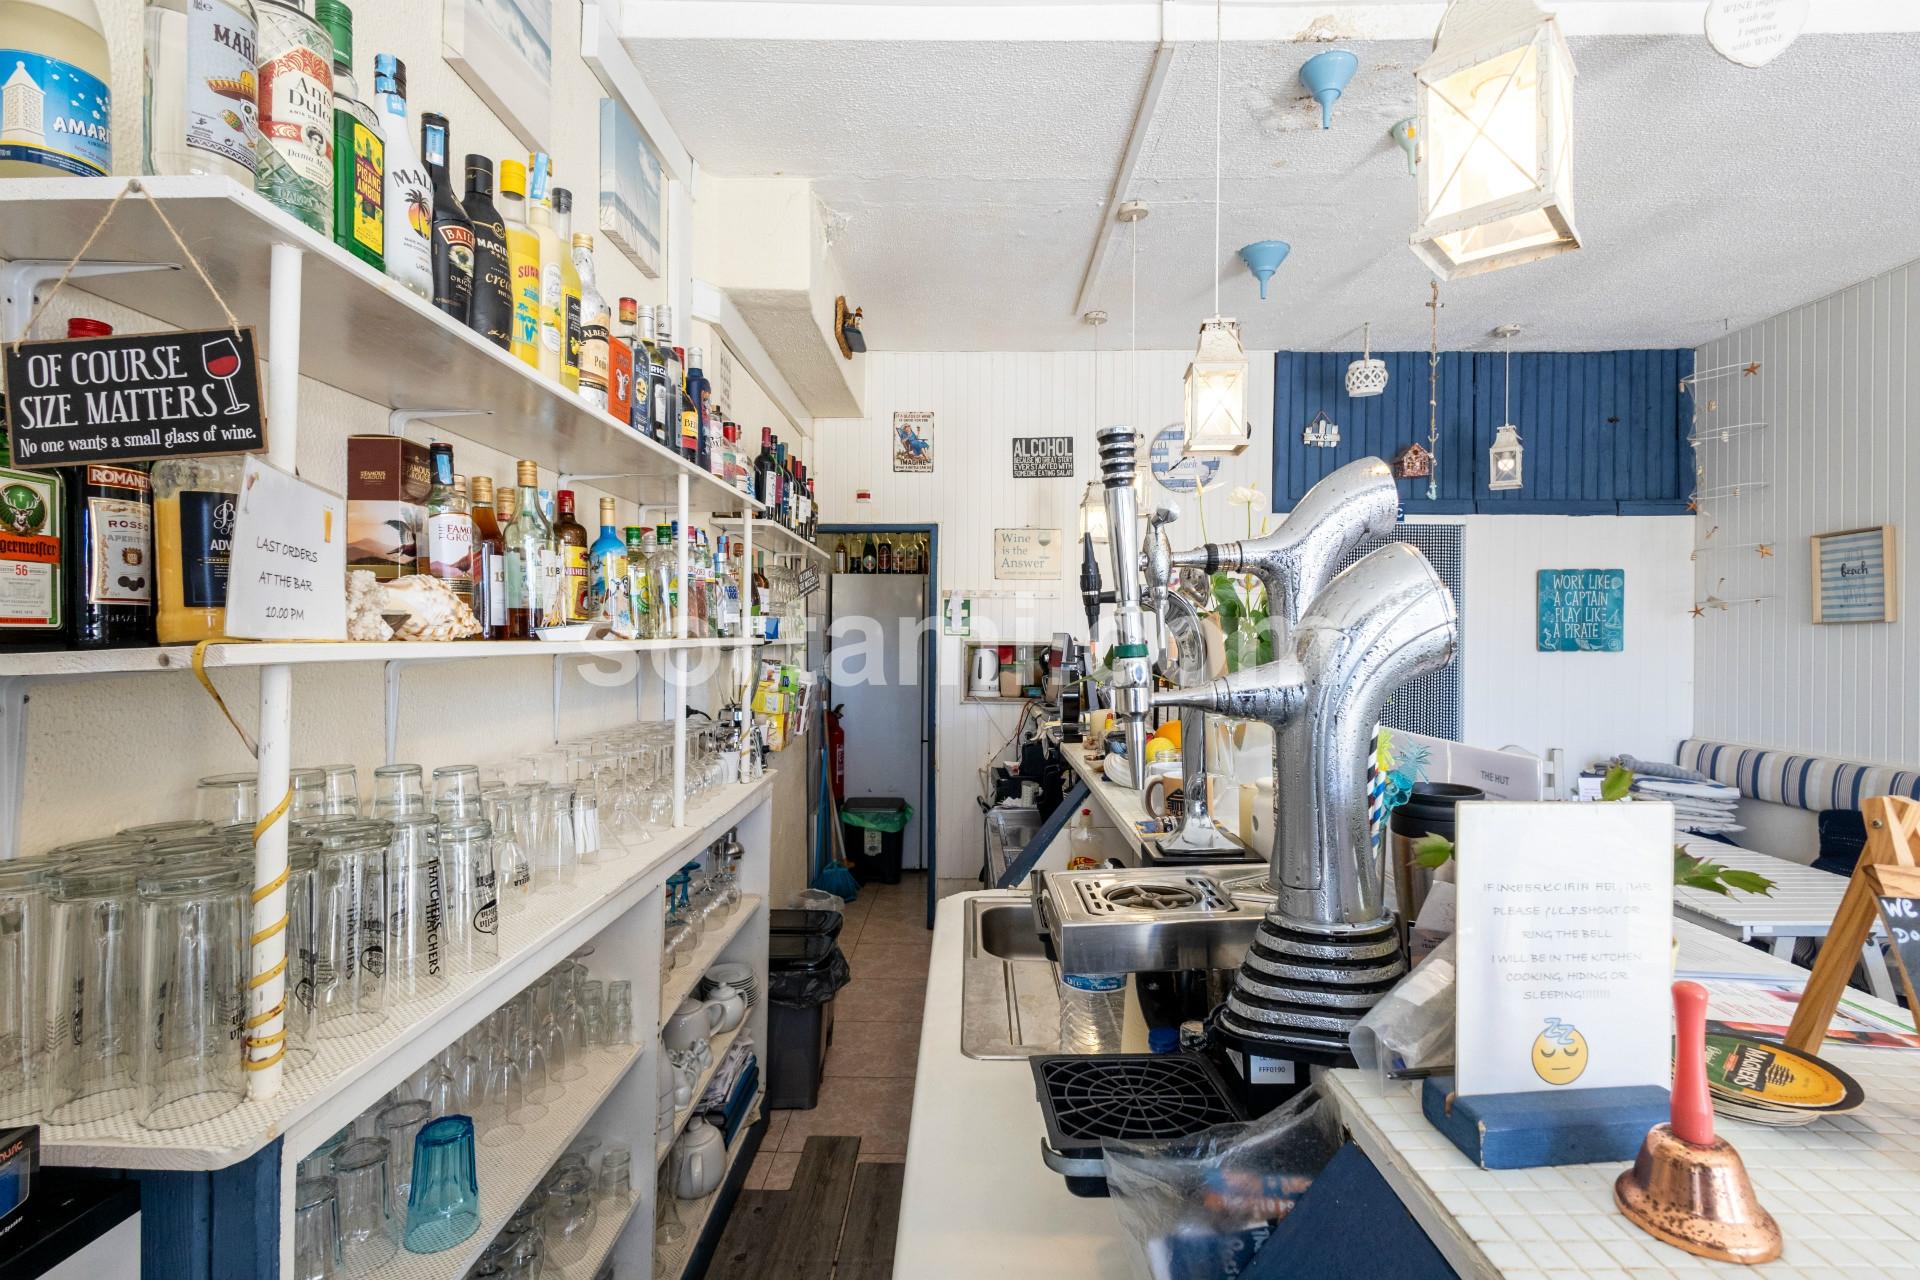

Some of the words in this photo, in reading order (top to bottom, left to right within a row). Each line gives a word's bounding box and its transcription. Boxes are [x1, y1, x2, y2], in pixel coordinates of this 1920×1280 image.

[27, 354, 62, 388] OF
[71, 345, 188, 385] COURSE
[20, 393, 78, 430] SIZE
[86, 383, 219, 425] MATTERS
[20, 438, 38, 458] No
[41, 440, 65, 454] one
[68, 433, 108, 453] wants
[111, 437, 121, 448] a
[124, 428, 161, 447] small
[165, 428, 200, 449] glass
[203, 425, 218, 443] of
[221, 425, 257, 441] wine.
[1013, 438, 1073, 457] ALCOHOL
[1014, 463, 1030, 471] EVER
[1058, 462, 1073, 470] WITH
[1034, 456, 1041, 464] NO
[1001, 533, 1031, 544] Wine
[256, 536, 281, 554] LAST
[282, 543, 319, 564] ORDERS
[1002, 545, 1010, 556] is
[1013, 545, 1028, 556] the
[15, 564, 28, 576] 56
[1001, 557, 1045, 569] Answer
[259, 571, 273, 584] AT
[272, 573, 293, 590] THE
[292, 577, 314, 592] BAR
[1553, 574, 1585, 590] WORK
[1589, 574, 1610, 590] LIKE
[1553, 591, 1560, 606] A
[1565, 591, 1608, 606] CAPTAIN
[265, 606, 288, 620] 10.00
[289, 608, 305, 621] PM
[1555, 607, 1582, 623] PLAY
[1585, 607, 1607, 622] LIKE
[1553, 623, 1560, 639] A
[1564, 623, 1598, 639] PIRATE
[1480, 770, 1496, 782] THE
[1494, 772, 1510, 785] HUT
[1493, 906, 1541, 916] PLEASE
[425, 904, 441, 976] THATCHERS
[1522, 930, 1553, 939] RING
[1556, 930, 1578, 939] THE
[1582, 930, 1613, 938] BELL
[1498, 954, 1527, 963] WILL
[1531, 953, 1545, 962] BE
[1549, 953, 1562, 961] IN
[1565, 953, 1588, 962] THE
[1591, 952, 1642, 962] KITCHEN
[1733, 1047, 1770, 1089] MAGNERS
